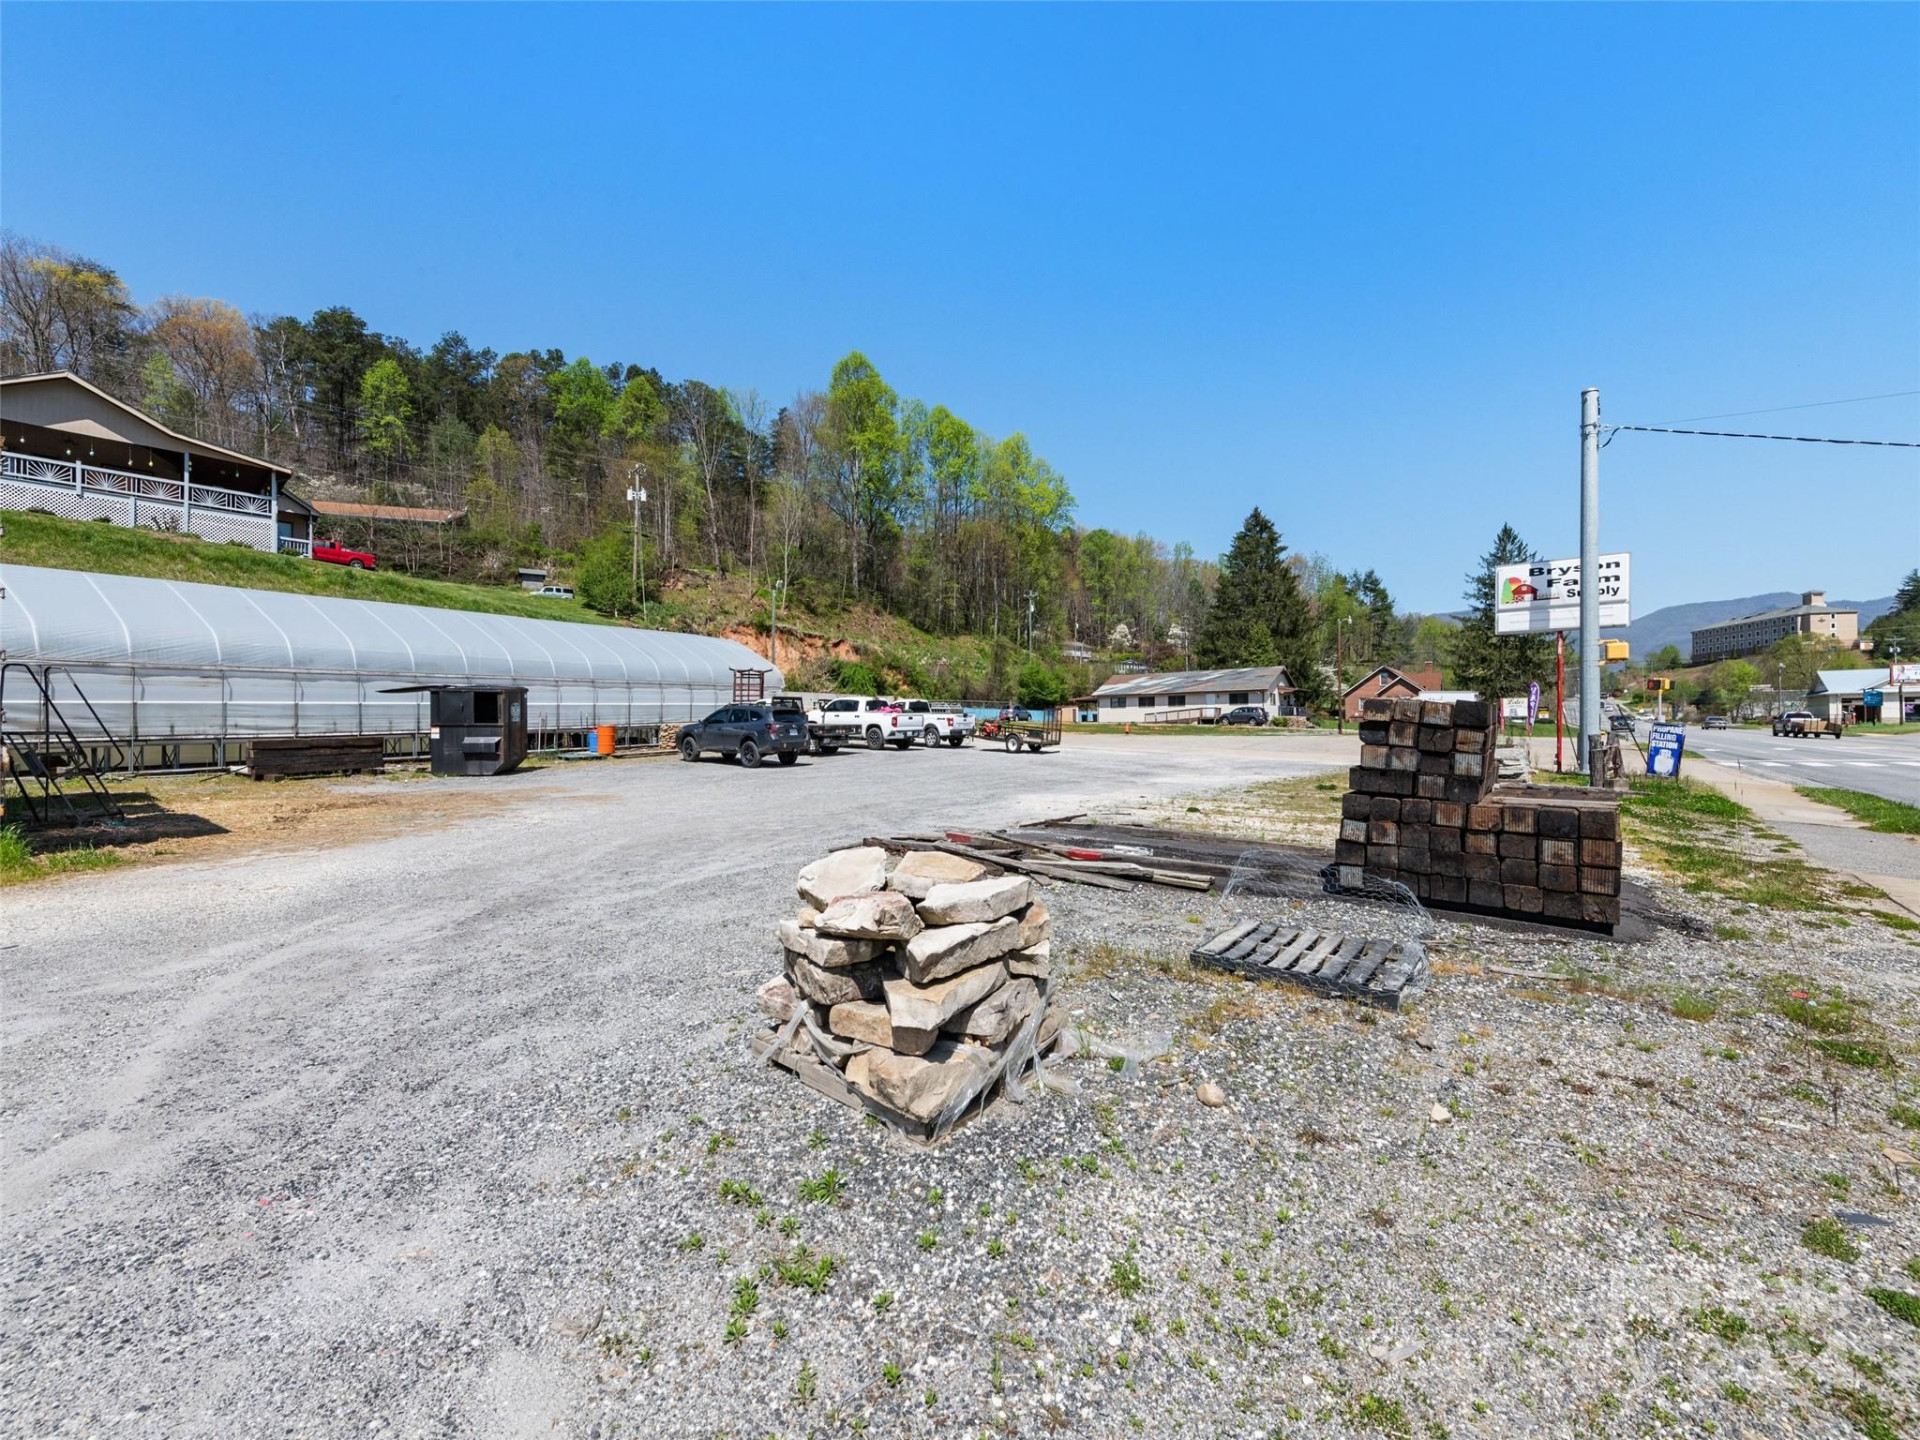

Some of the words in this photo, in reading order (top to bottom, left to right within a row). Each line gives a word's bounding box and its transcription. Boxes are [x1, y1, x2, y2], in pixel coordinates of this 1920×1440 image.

[1547, 575, 1620, 587] Fam
[1653, 725, 1684, 735] PROPANE
[1652, 732, 1677, 741] FILLING
[1651, 740, 1678, 749] STATION
